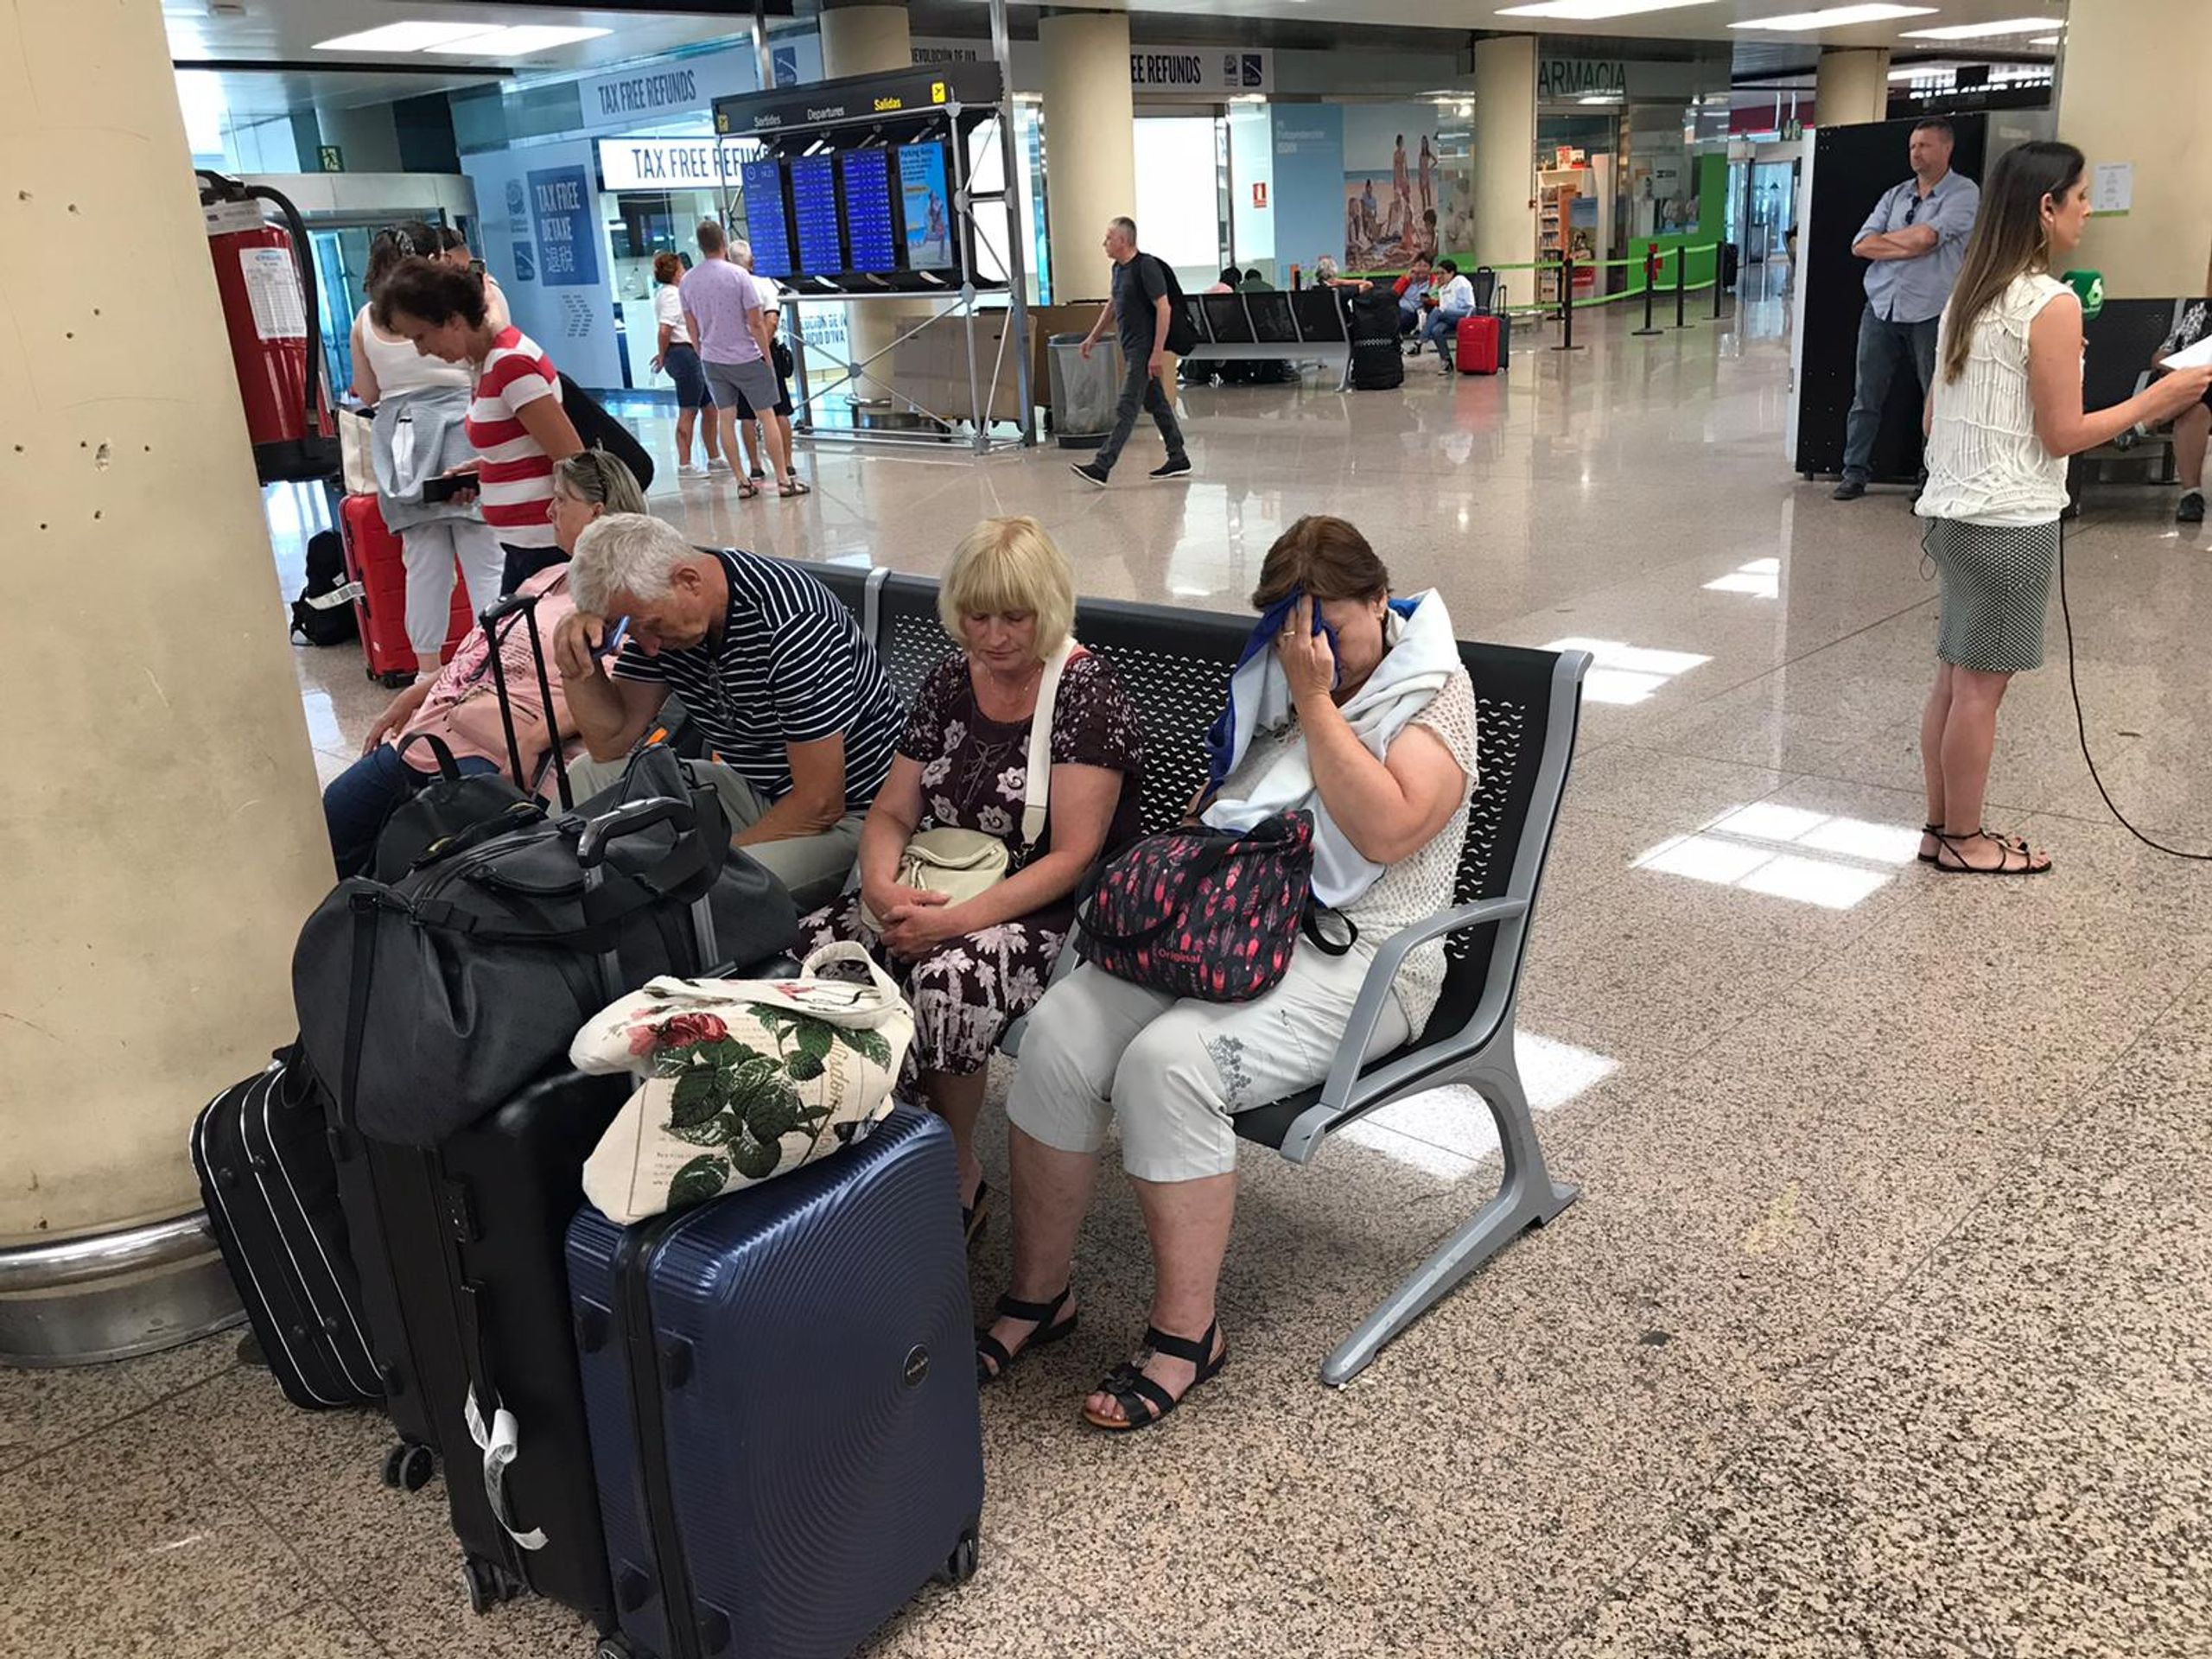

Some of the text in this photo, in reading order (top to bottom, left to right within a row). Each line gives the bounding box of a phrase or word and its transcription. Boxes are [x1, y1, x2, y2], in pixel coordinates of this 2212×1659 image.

[1130, 54, 1201, 84] EE REFUNDS
[1537, 60, 1626, 96] ARMACIA
[598, 69, 696, 115] TAX FREE REFUNDS
[807, 105, 845, 121] Departures
[874, 97, 901, 111] Salidas
[632, 149, 666, 179] TAX
[670, 147, 709, 178] FREE
[536, 181, 581, 213] TAX FREE
[541, 216, 574, 243] DETAXE
[1158, 947, 1201, 964] Original
